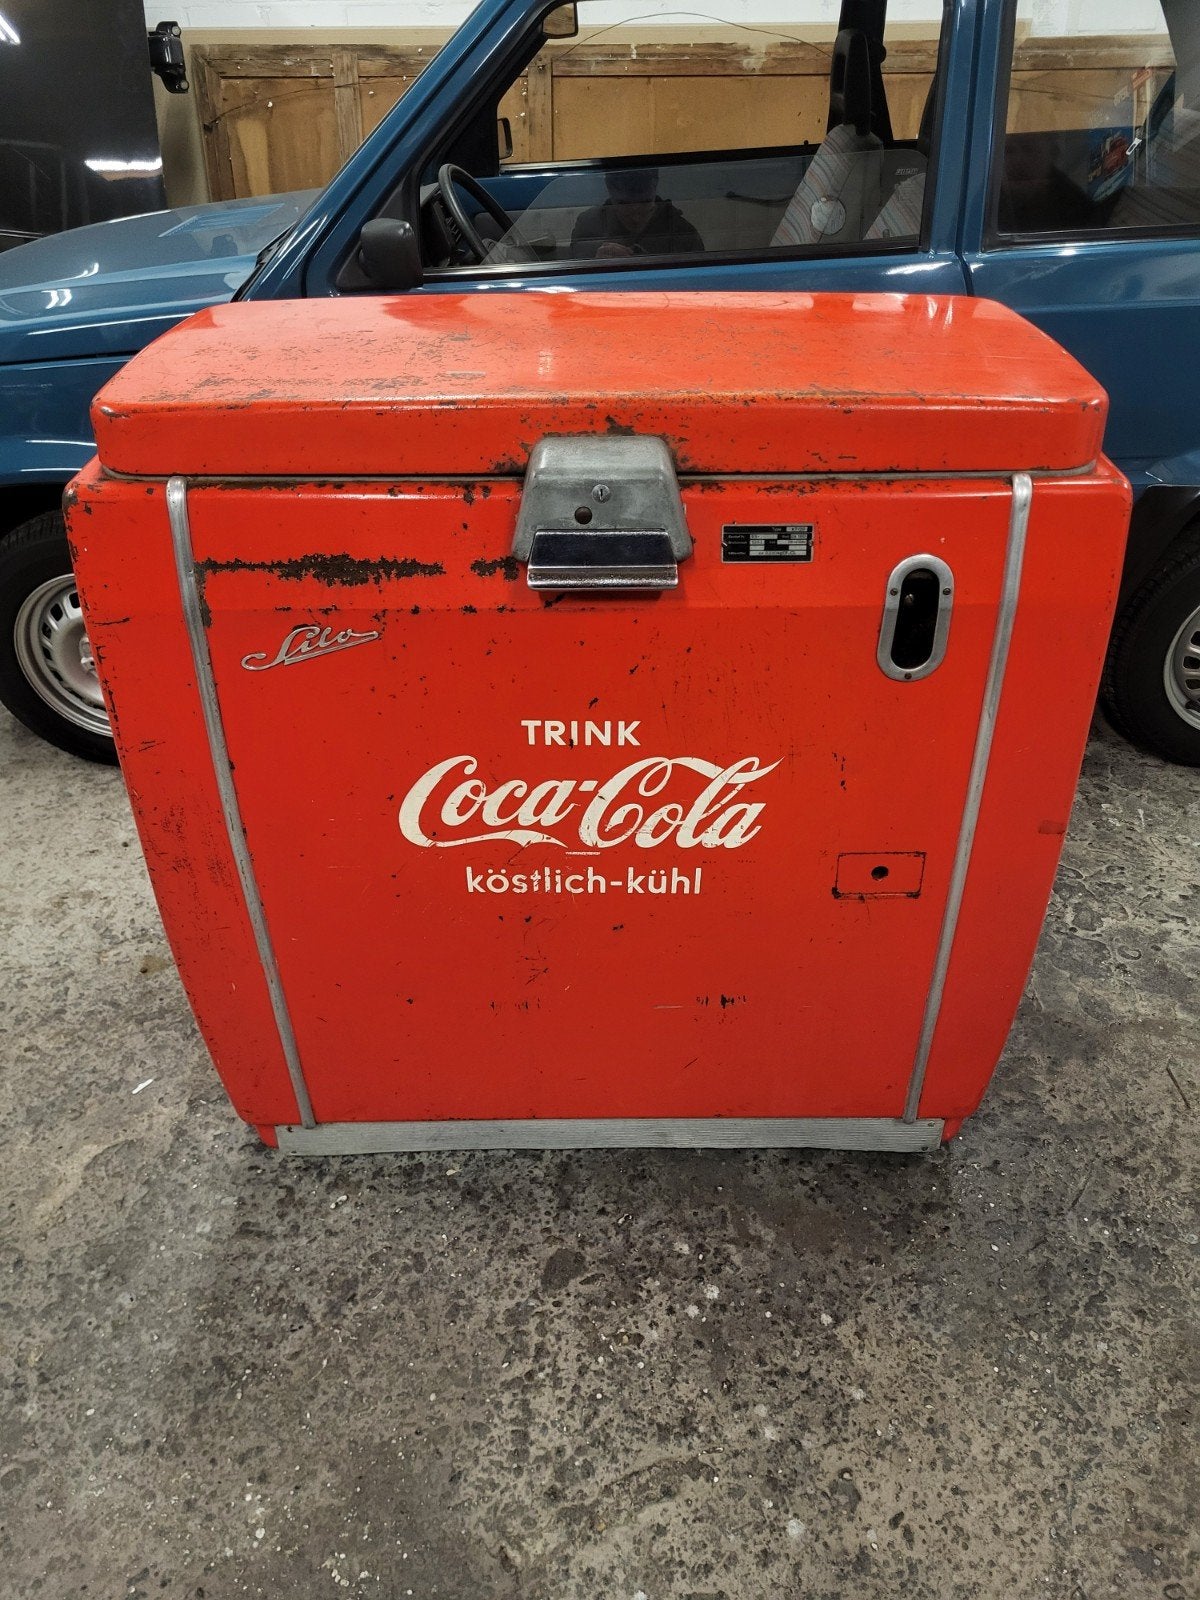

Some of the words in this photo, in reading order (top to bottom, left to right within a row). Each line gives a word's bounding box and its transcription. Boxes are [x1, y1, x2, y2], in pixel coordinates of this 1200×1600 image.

[520, 719, 641, 746] TRINK
[398, 755, 785, 849] Coca-Cola
[465, 866, 702, 895] köstlich-kühl
